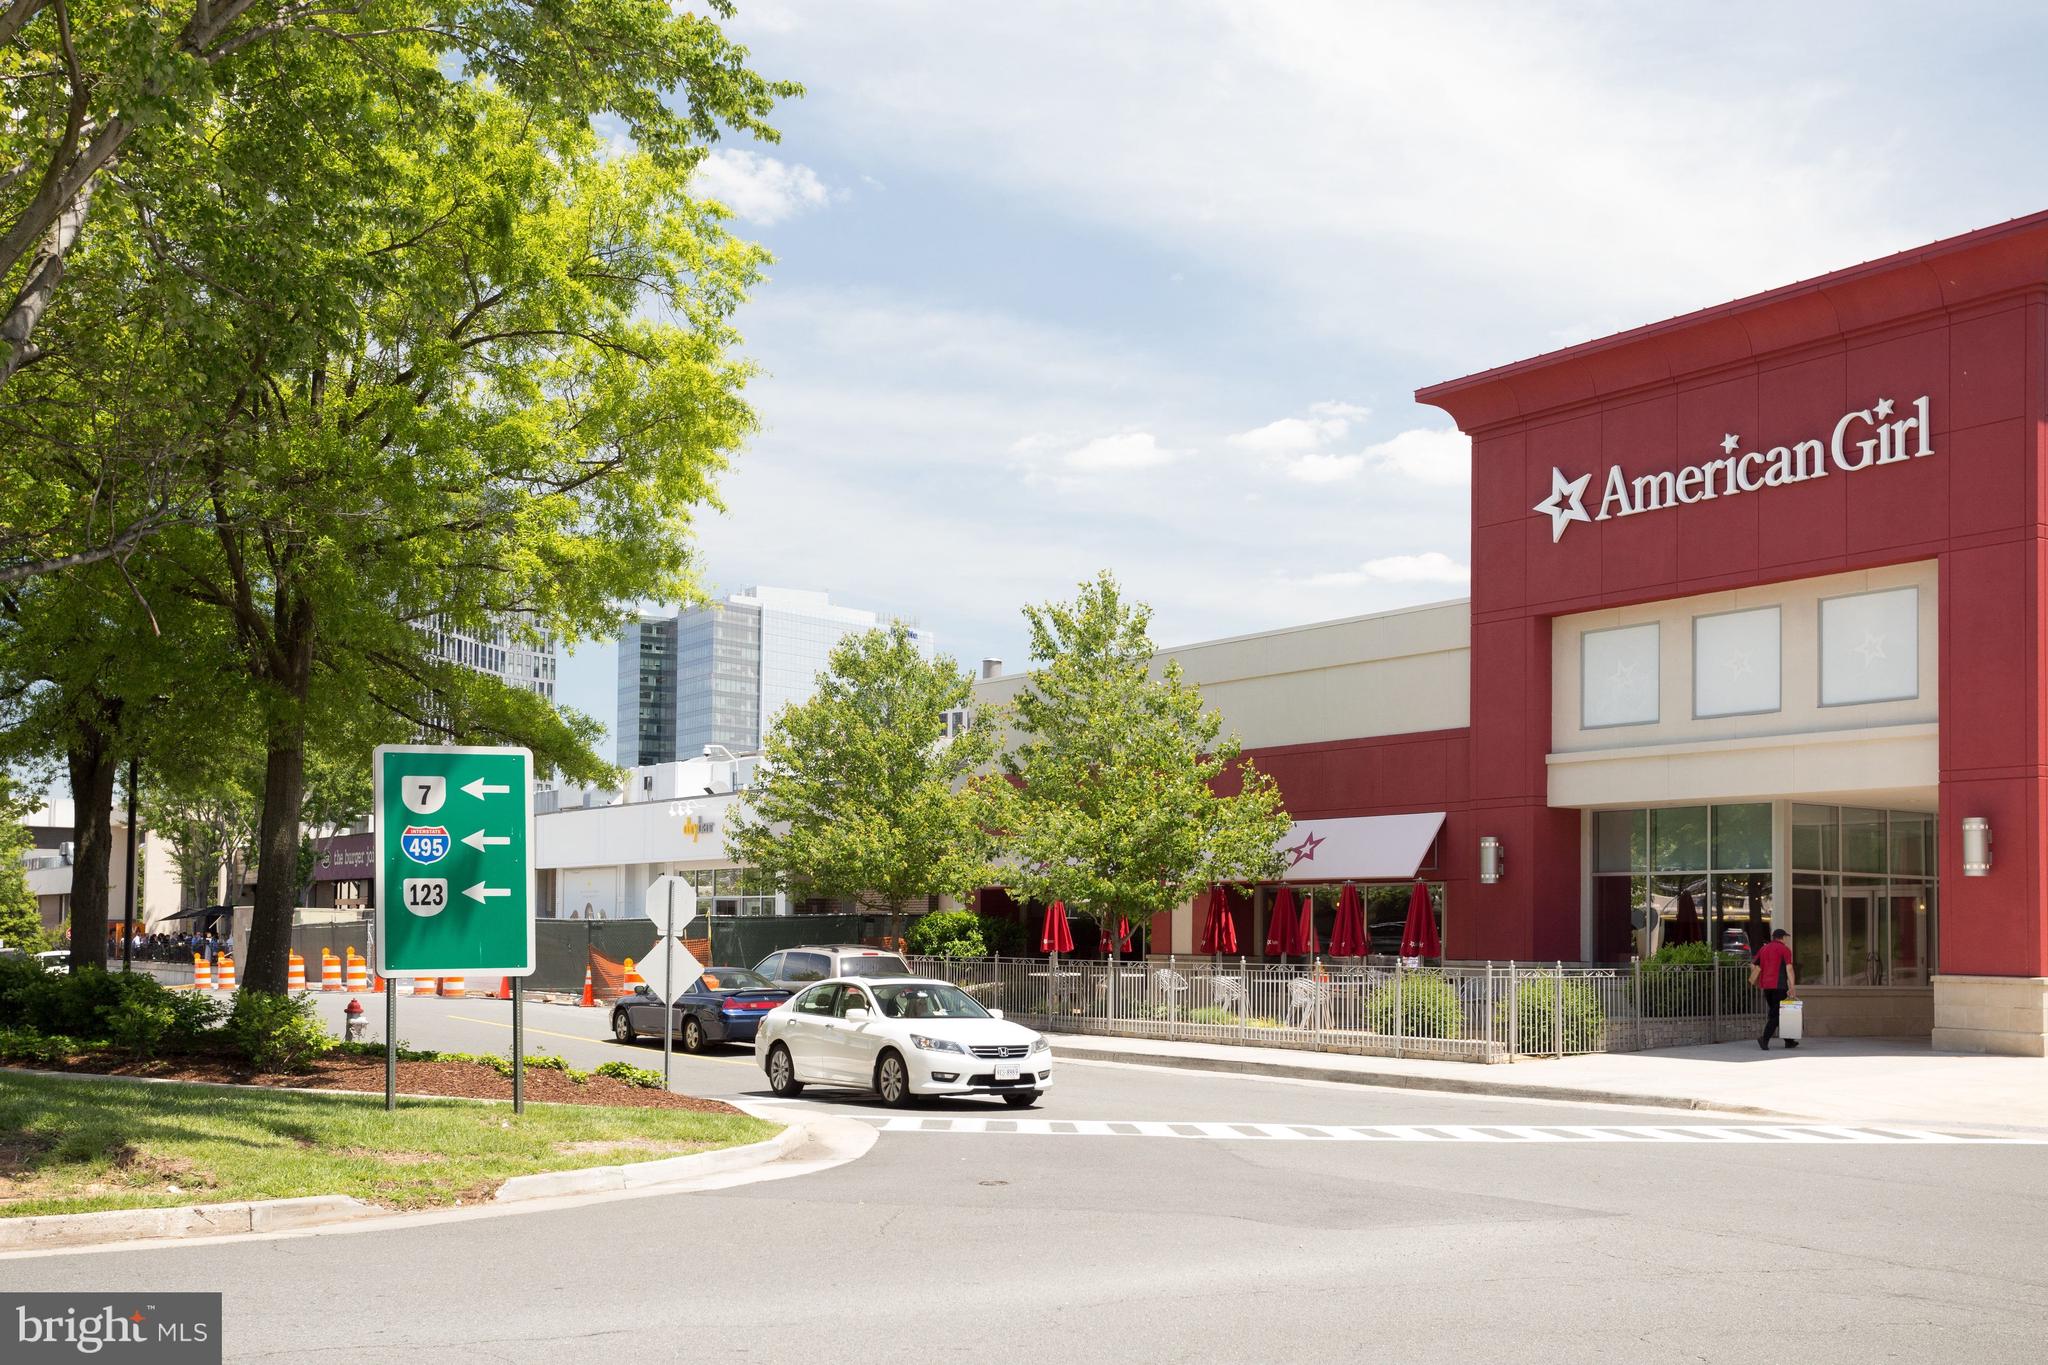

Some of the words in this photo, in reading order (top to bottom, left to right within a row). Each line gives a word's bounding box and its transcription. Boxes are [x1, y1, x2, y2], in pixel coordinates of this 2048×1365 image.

[1595, 433, 1829, 520] American
[1831, 396, 1935, 471] Girl
[418, 785, 431, 805] 7
[409, 838, 443, 857] 495
[333, 849, 344, 865] the
[345, 849, 364, 867] burger
[410, 884, 443, 906] 123
